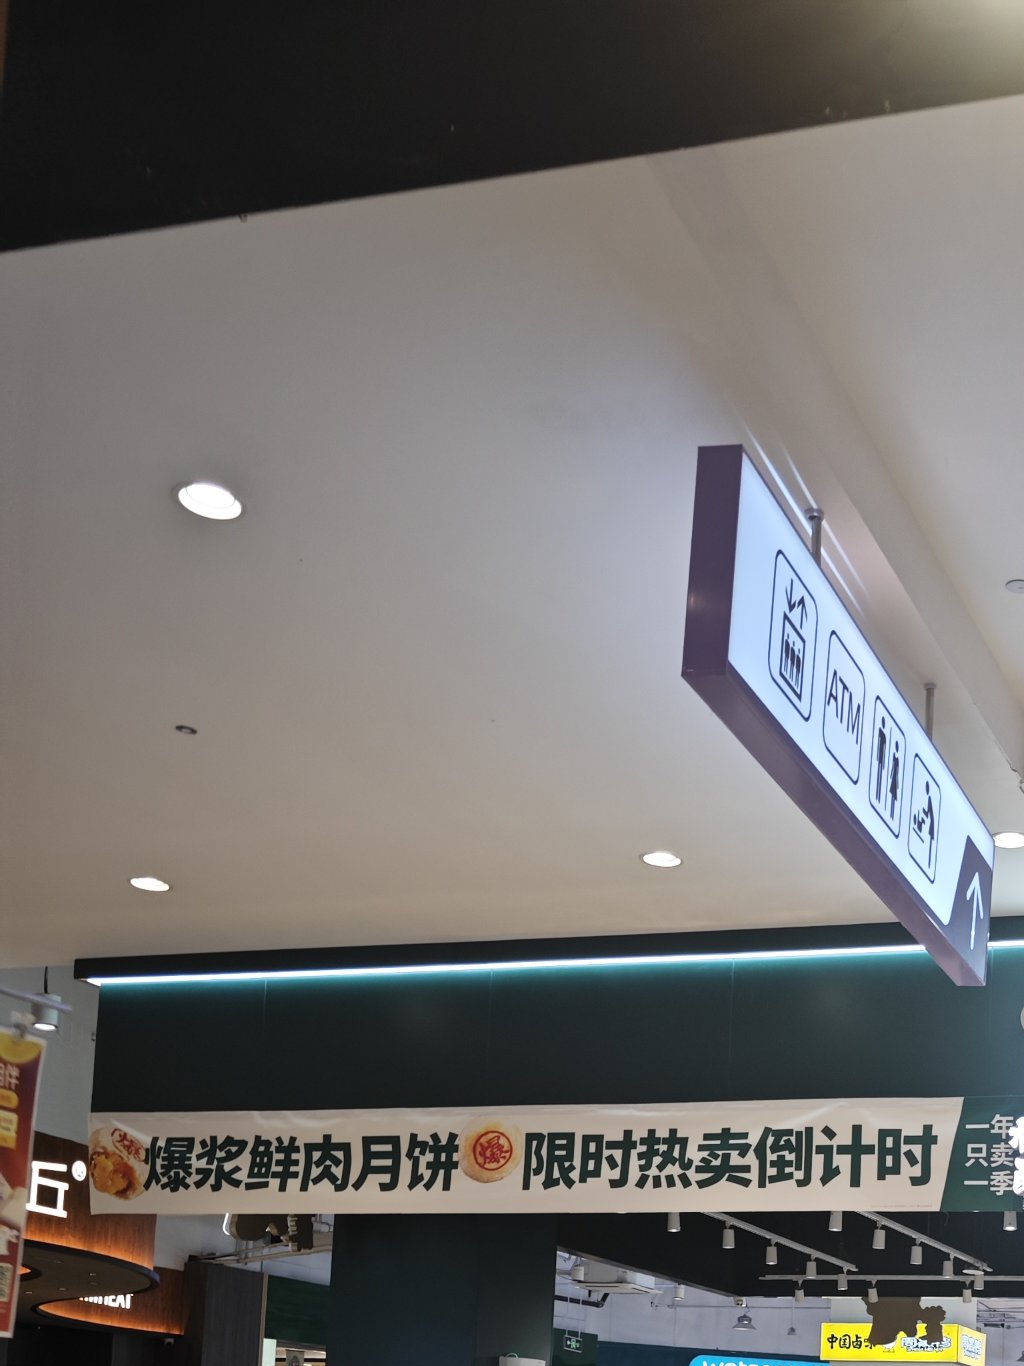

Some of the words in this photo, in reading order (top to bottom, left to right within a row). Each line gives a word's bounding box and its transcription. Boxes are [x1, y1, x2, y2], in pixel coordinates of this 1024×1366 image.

[827, 667, 862, 748] ATM
[965, 1114, 1014, 1140] 一年
[143, 1131, 459, 1193] 爆浆鲜肉月饼
[522, 1124, 938, 1191] 限时热卖倒计时
[965, 1142, 1014, 1168] 只卖
[963, 1171, 1014, 1196] 一季
